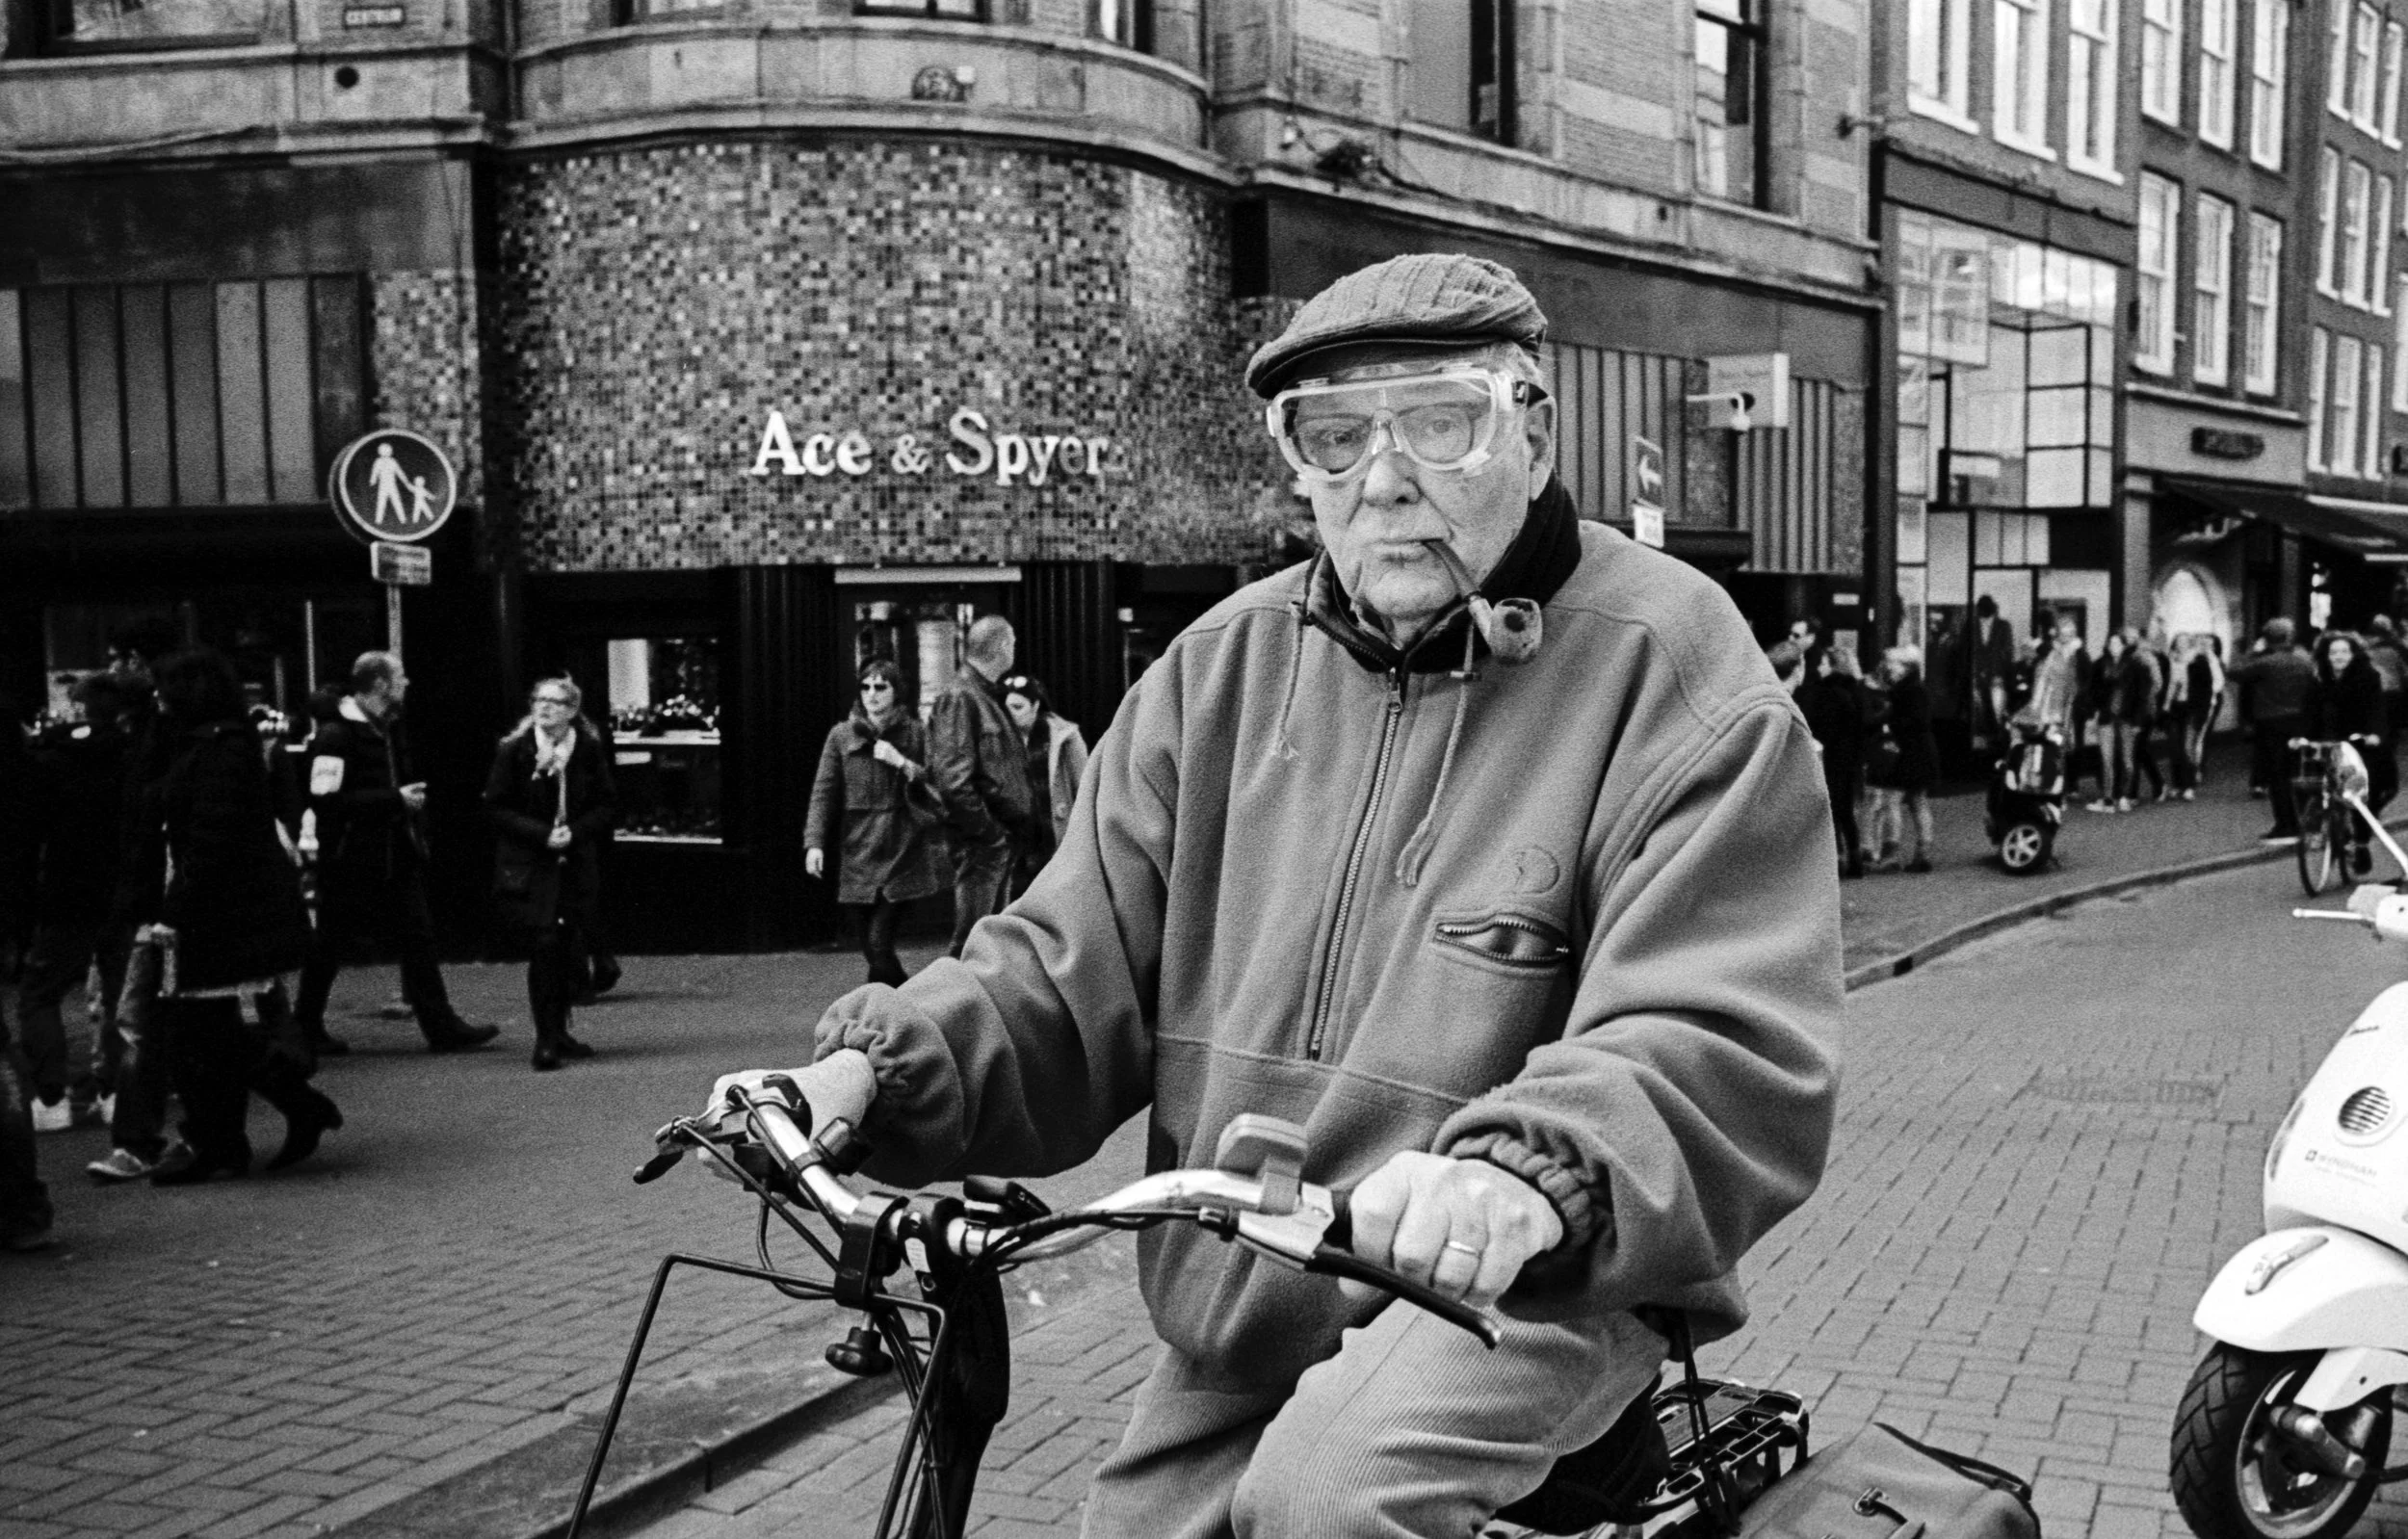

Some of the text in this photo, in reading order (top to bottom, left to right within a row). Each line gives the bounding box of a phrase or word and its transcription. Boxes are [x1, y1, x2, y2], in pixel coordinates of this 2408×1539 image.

[750, 408, 1109, 485] Ace & Spyer
